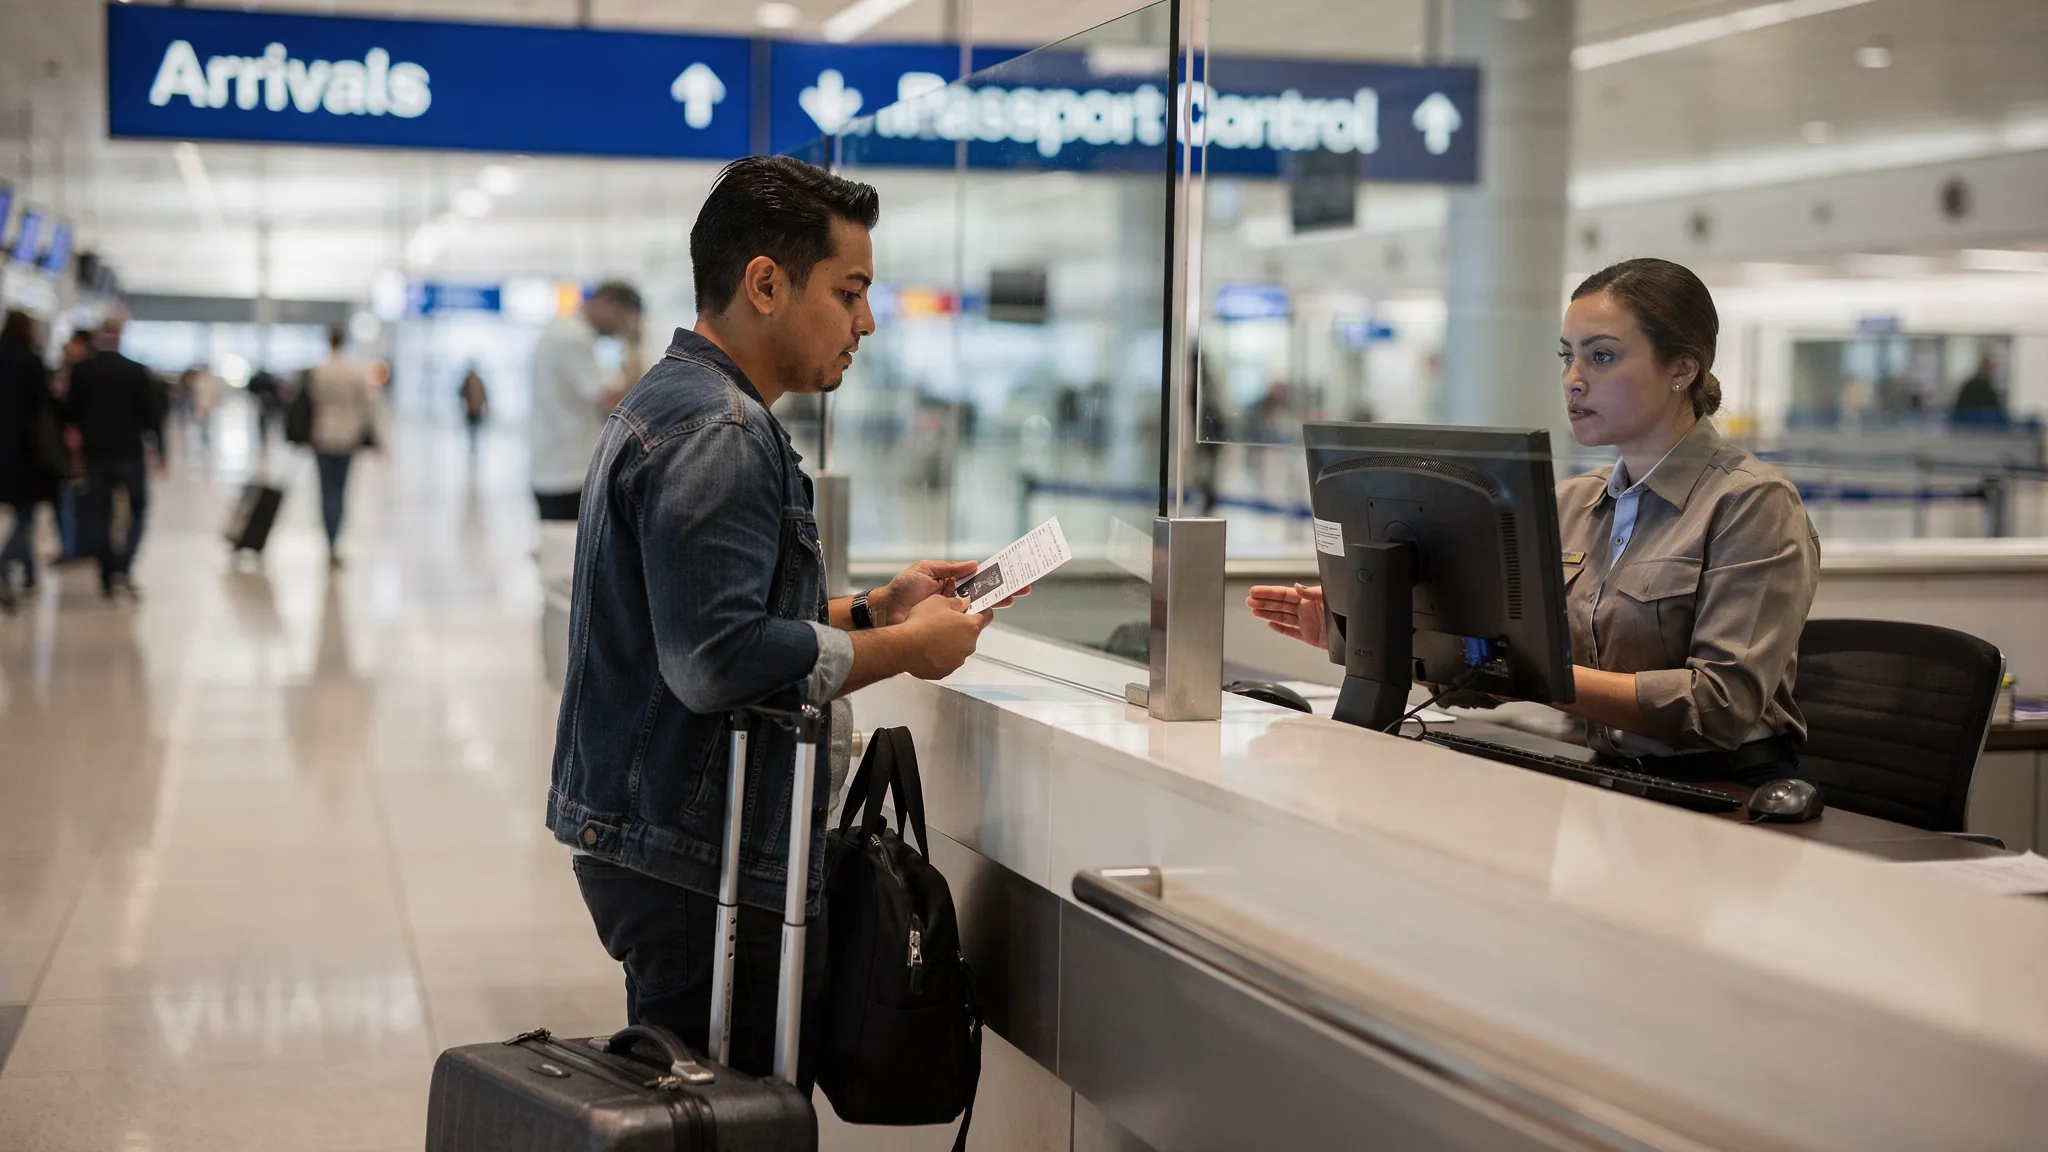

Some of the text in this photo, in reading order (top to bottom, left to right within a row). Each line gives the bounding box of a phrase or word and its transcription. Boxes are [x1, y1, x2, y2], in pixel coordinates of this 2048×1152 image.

[149, 39, 432, 118] Arrivals
[897, 71, 1378, 157] Passport Control
